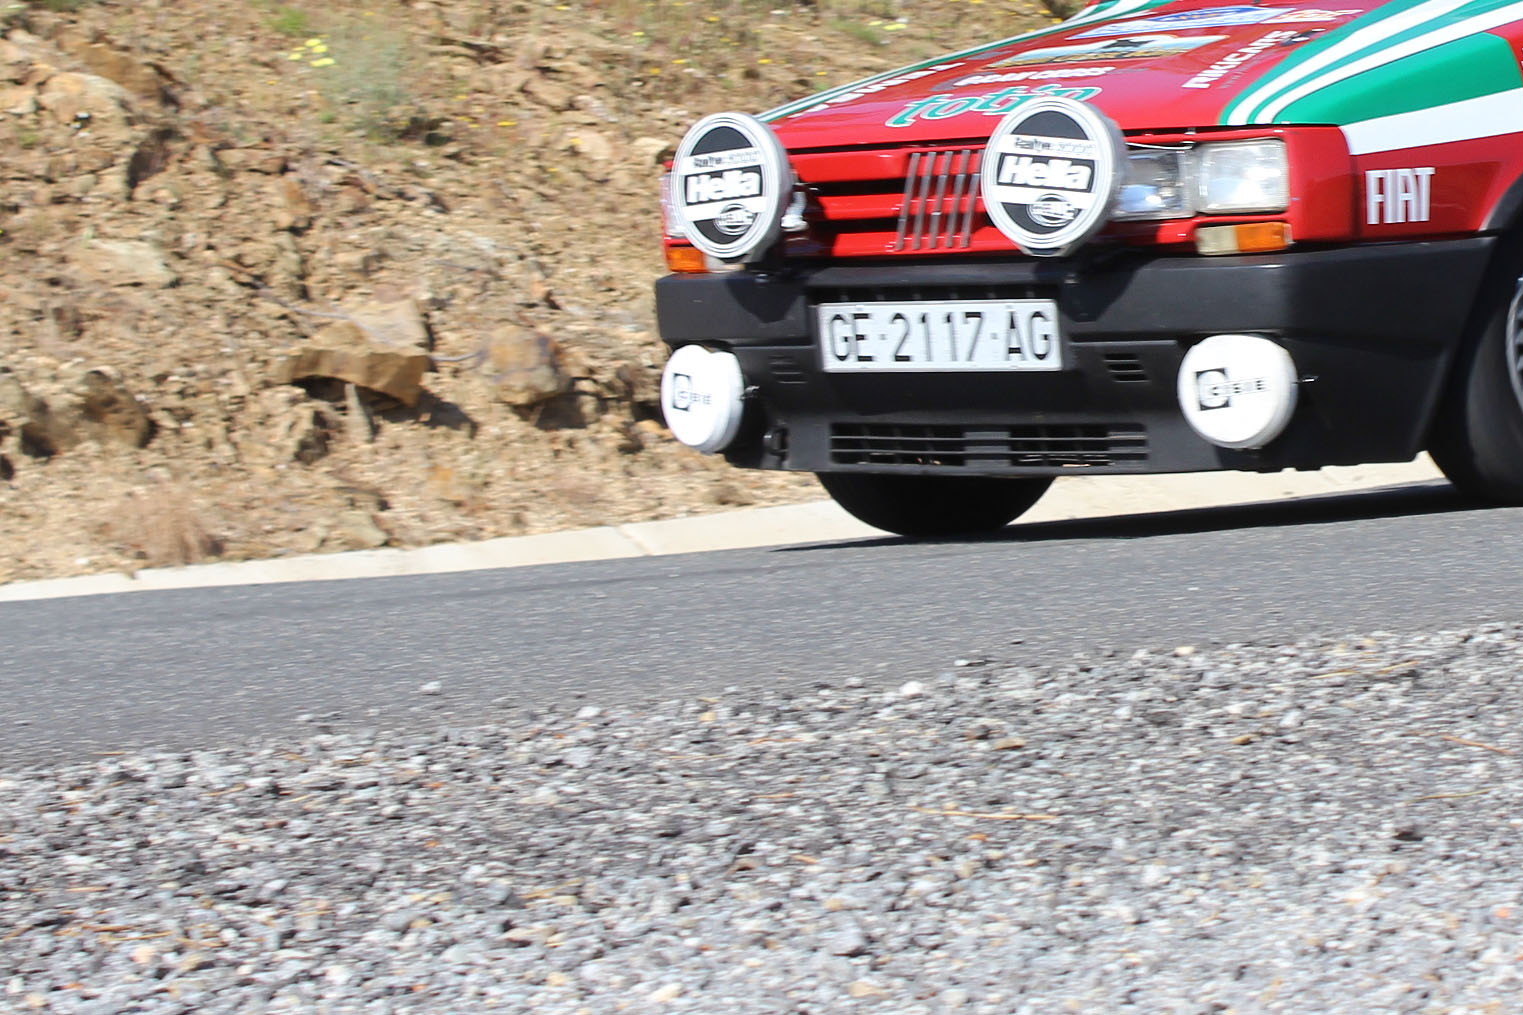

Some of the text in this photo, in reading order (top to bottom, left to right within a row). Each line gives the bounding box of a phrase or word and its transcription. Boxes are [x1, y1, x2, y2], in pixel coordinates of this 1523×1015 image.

[686, 170, 761, 203] Hella
[998, 155, 1092, 190] Hella
[1365, 167, 1436, 224] FIAT
